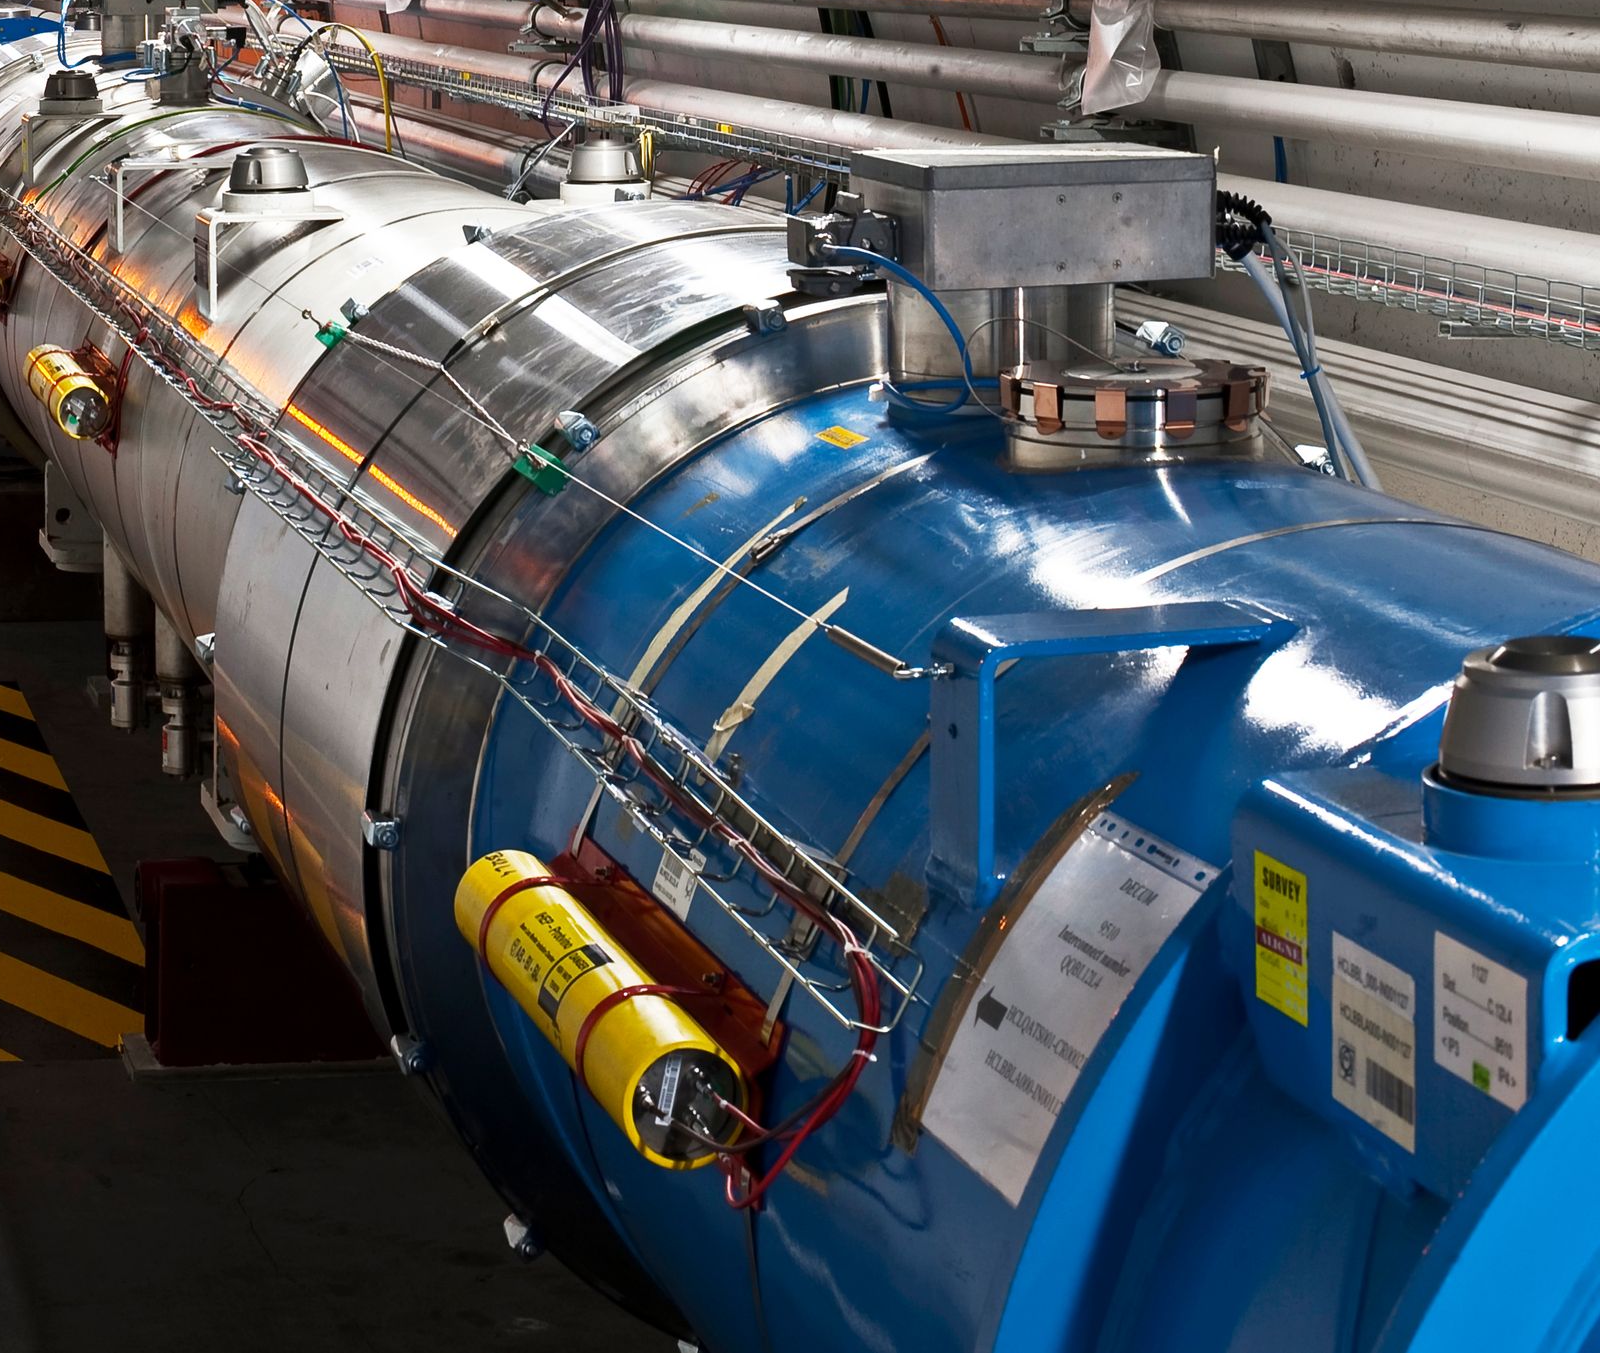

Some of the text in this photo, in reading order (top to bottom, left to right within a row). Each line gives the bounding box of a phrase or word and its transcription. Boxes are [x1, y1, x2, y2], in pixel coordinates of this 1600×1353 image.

[1262, 866, 1301, 904] SURVEY
[1059, 924, 1132, 979] Interconnect number
